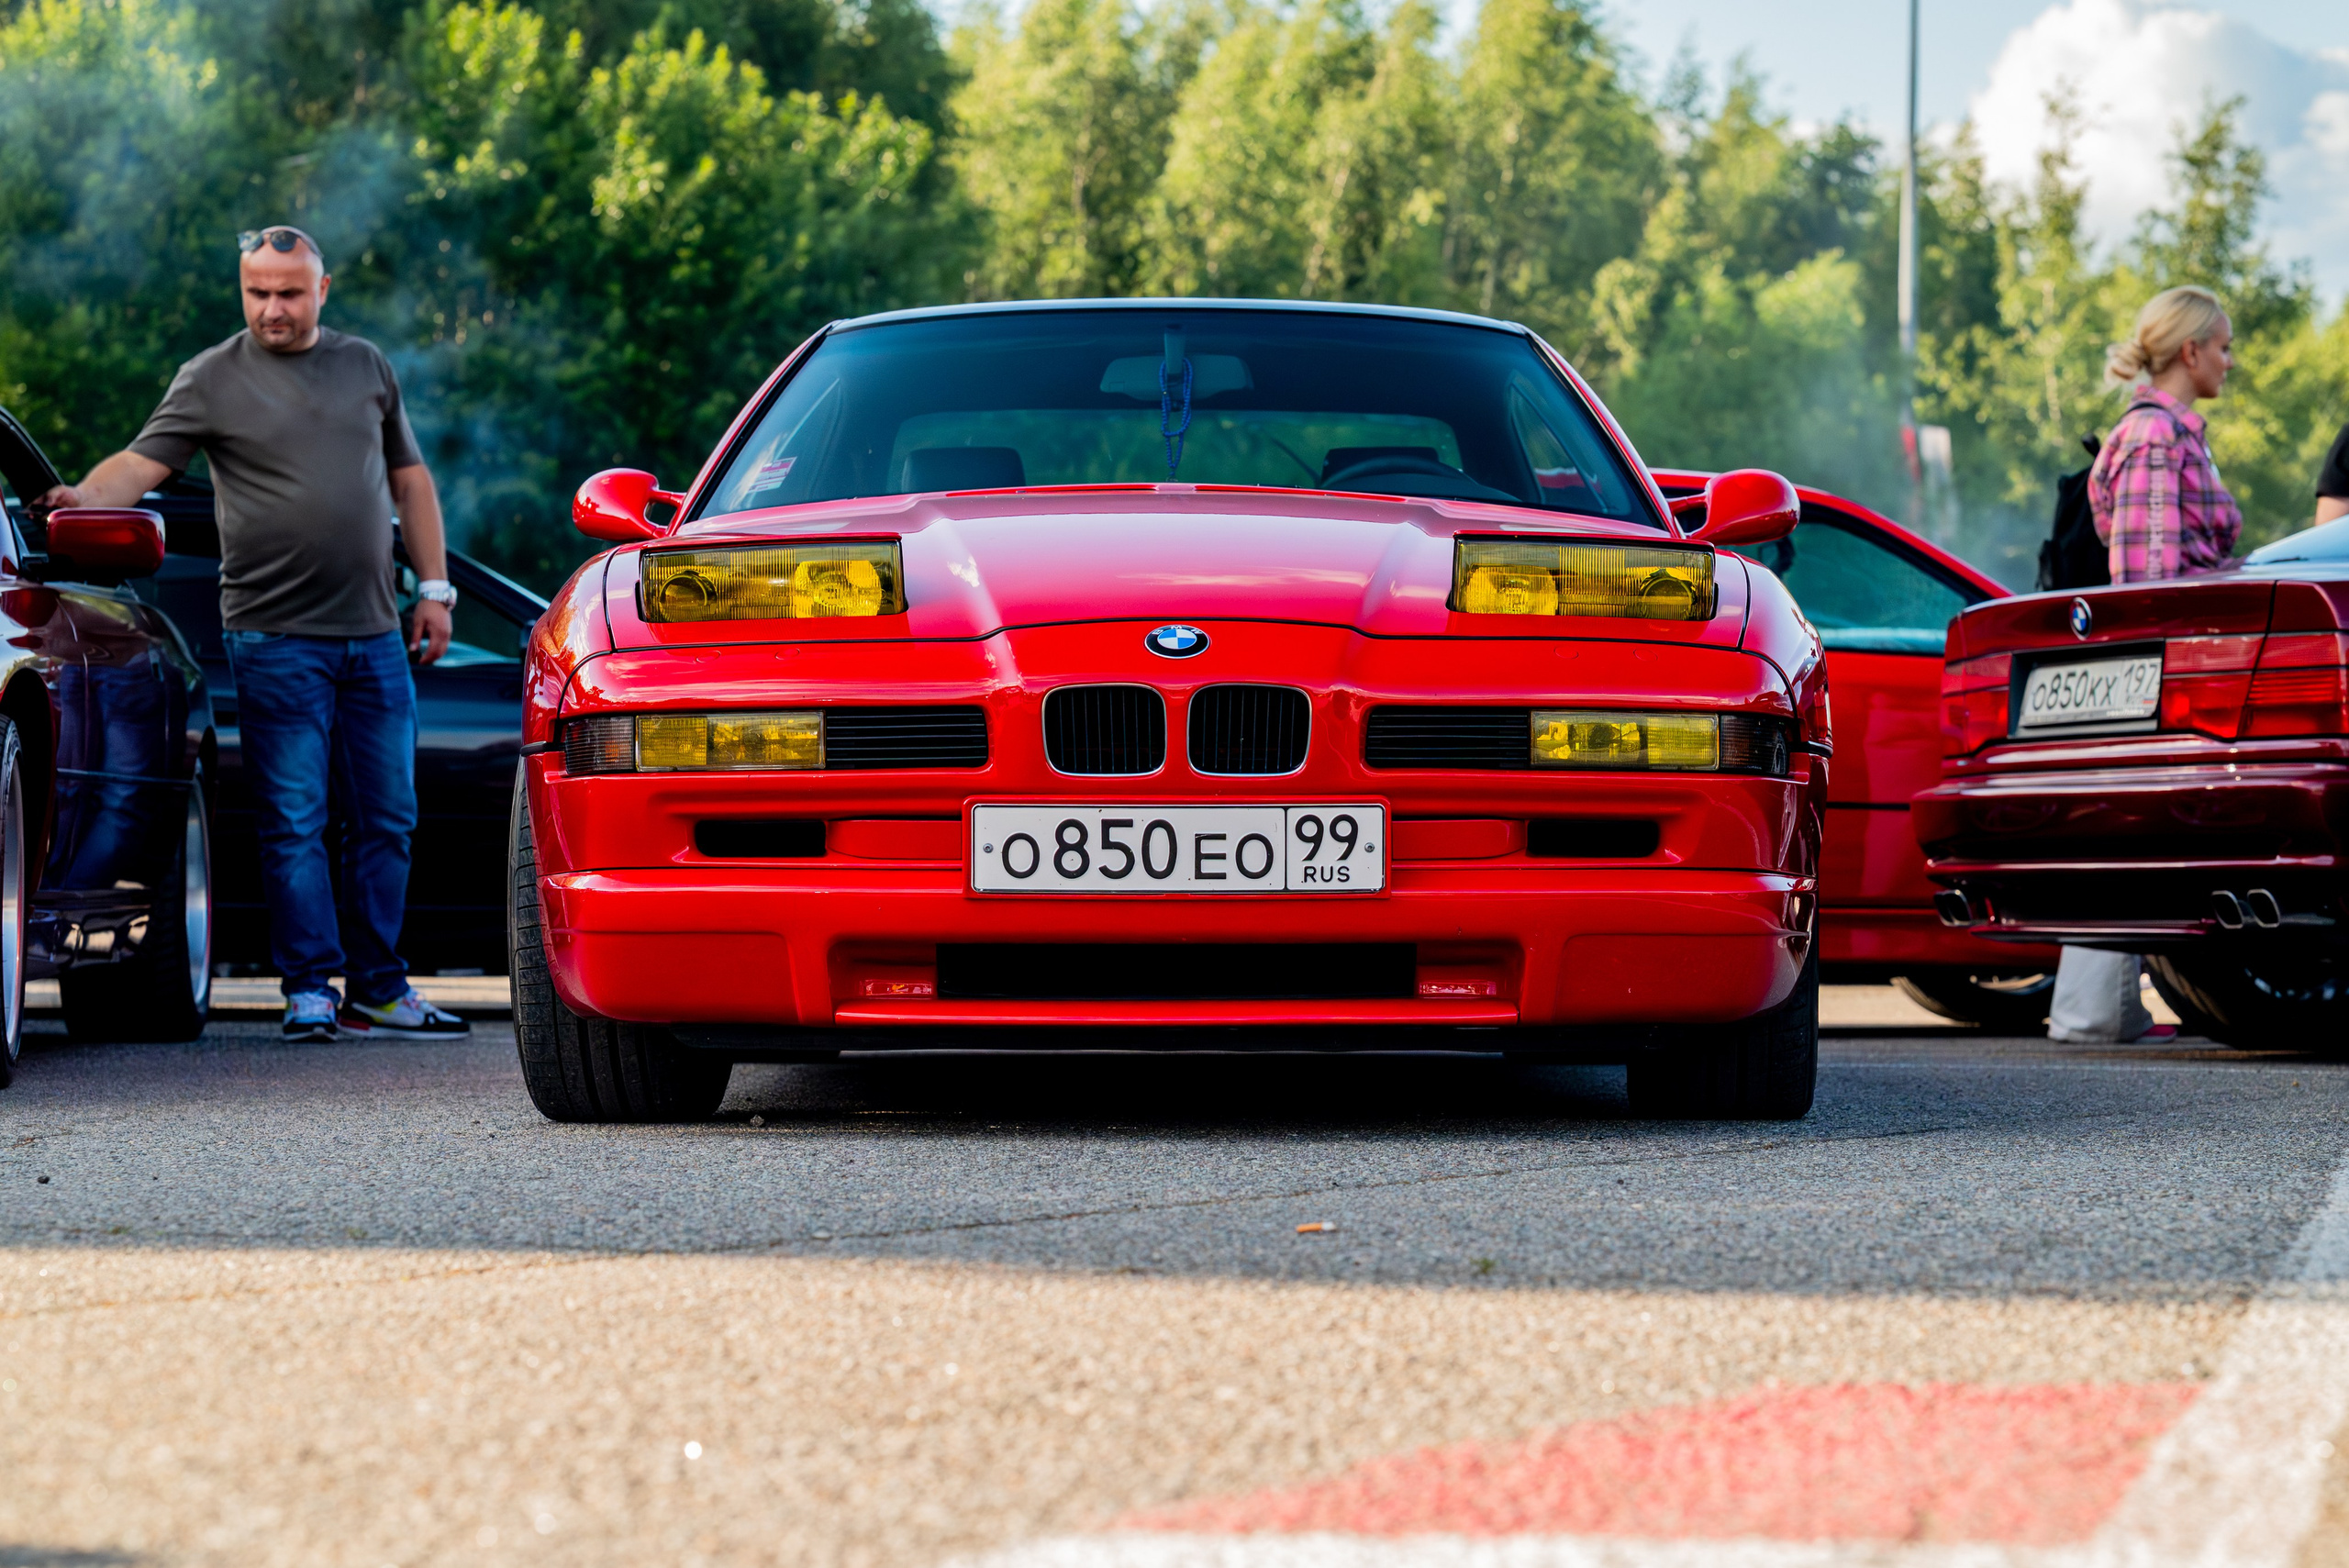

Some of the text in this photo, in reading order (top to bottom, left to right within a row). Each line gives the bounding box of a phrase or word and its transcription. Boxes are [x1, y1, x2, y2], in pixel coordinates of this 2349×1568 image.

[2124, 663, 2158, 694] 197
[1295, 814, 1359, 862] 99
[1304, 865, 1351, 884] RUS
